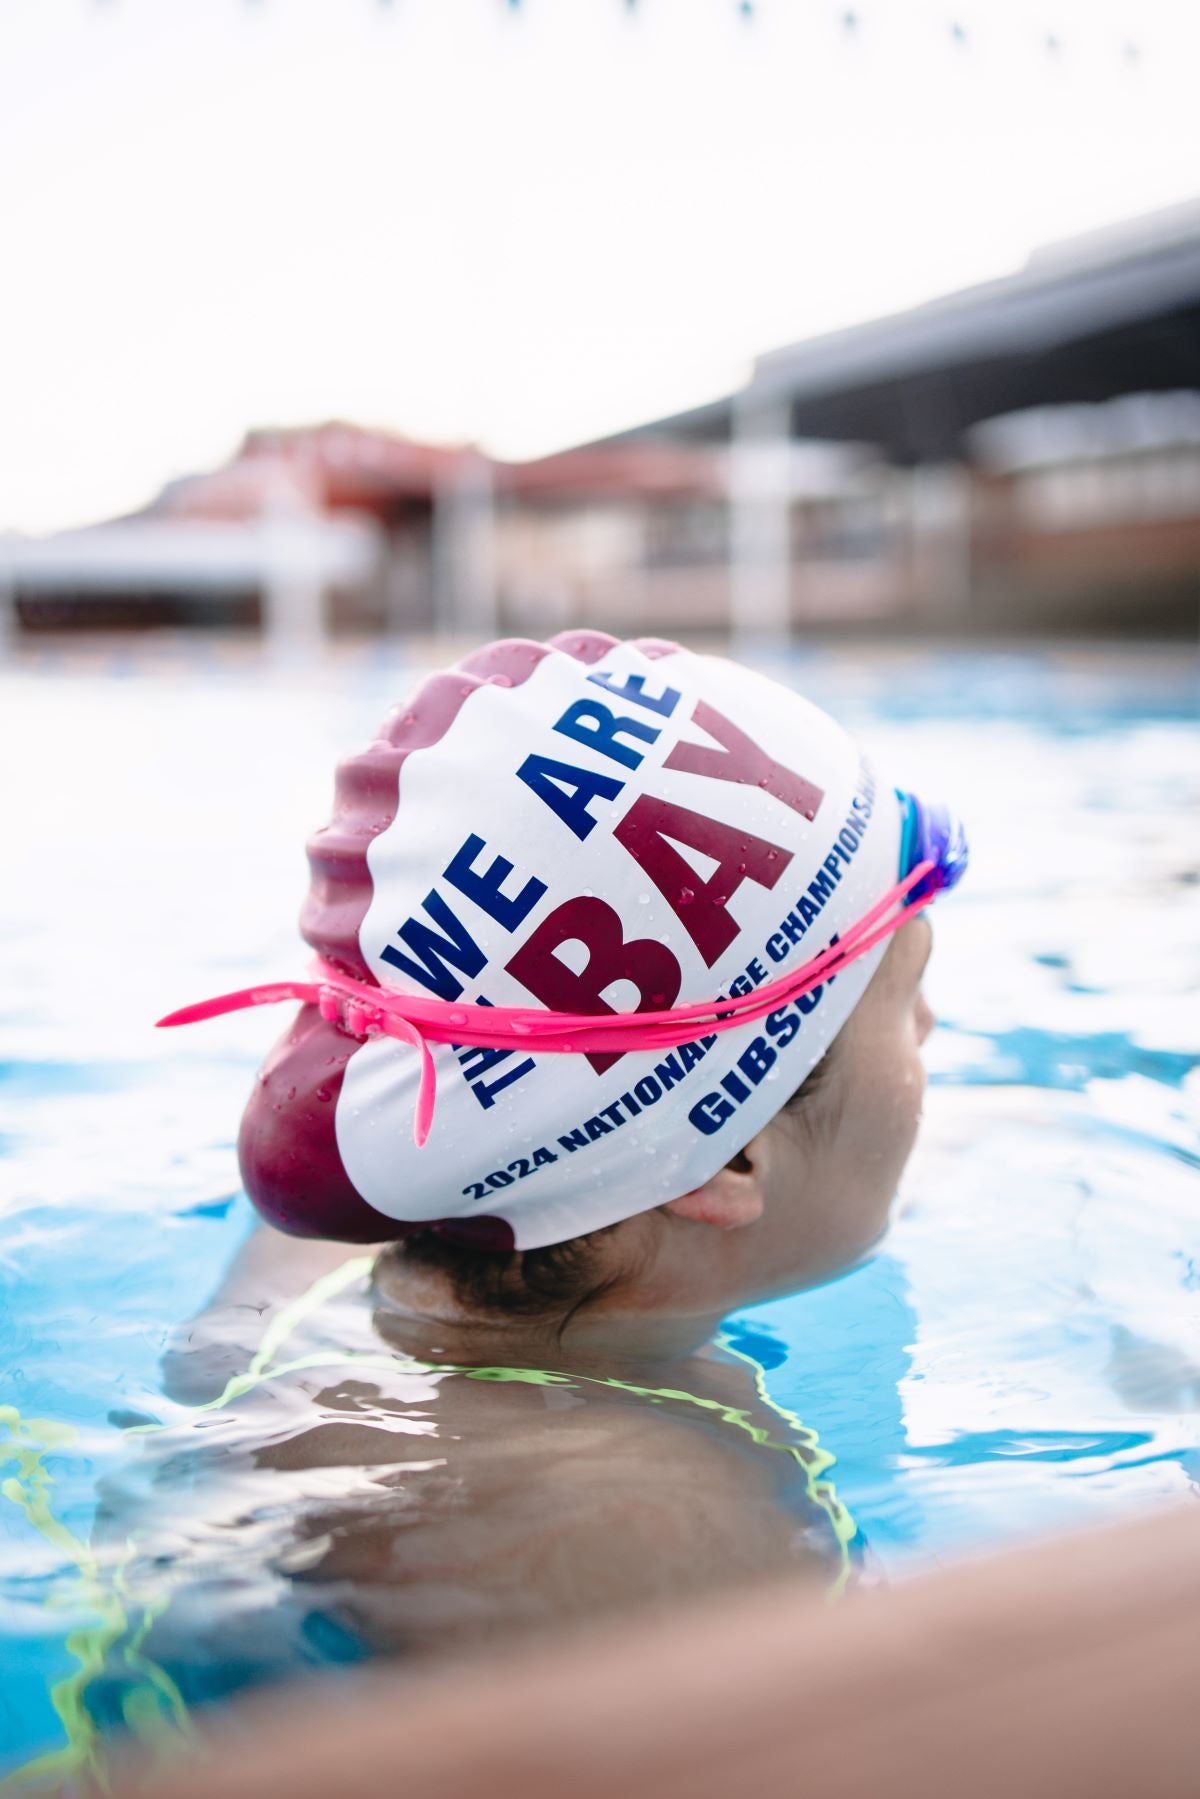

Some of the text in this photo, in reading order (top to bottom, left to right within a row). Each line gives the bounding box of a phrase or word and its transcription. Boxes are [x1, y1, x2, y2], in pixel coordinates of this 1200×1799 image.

[380, 671, 683, 1003] WE ARE
[504, 698, 825, 1077] BAY
[451, 994, 537, 1110] TH
[462, 1147, 559, 1200] 2024
